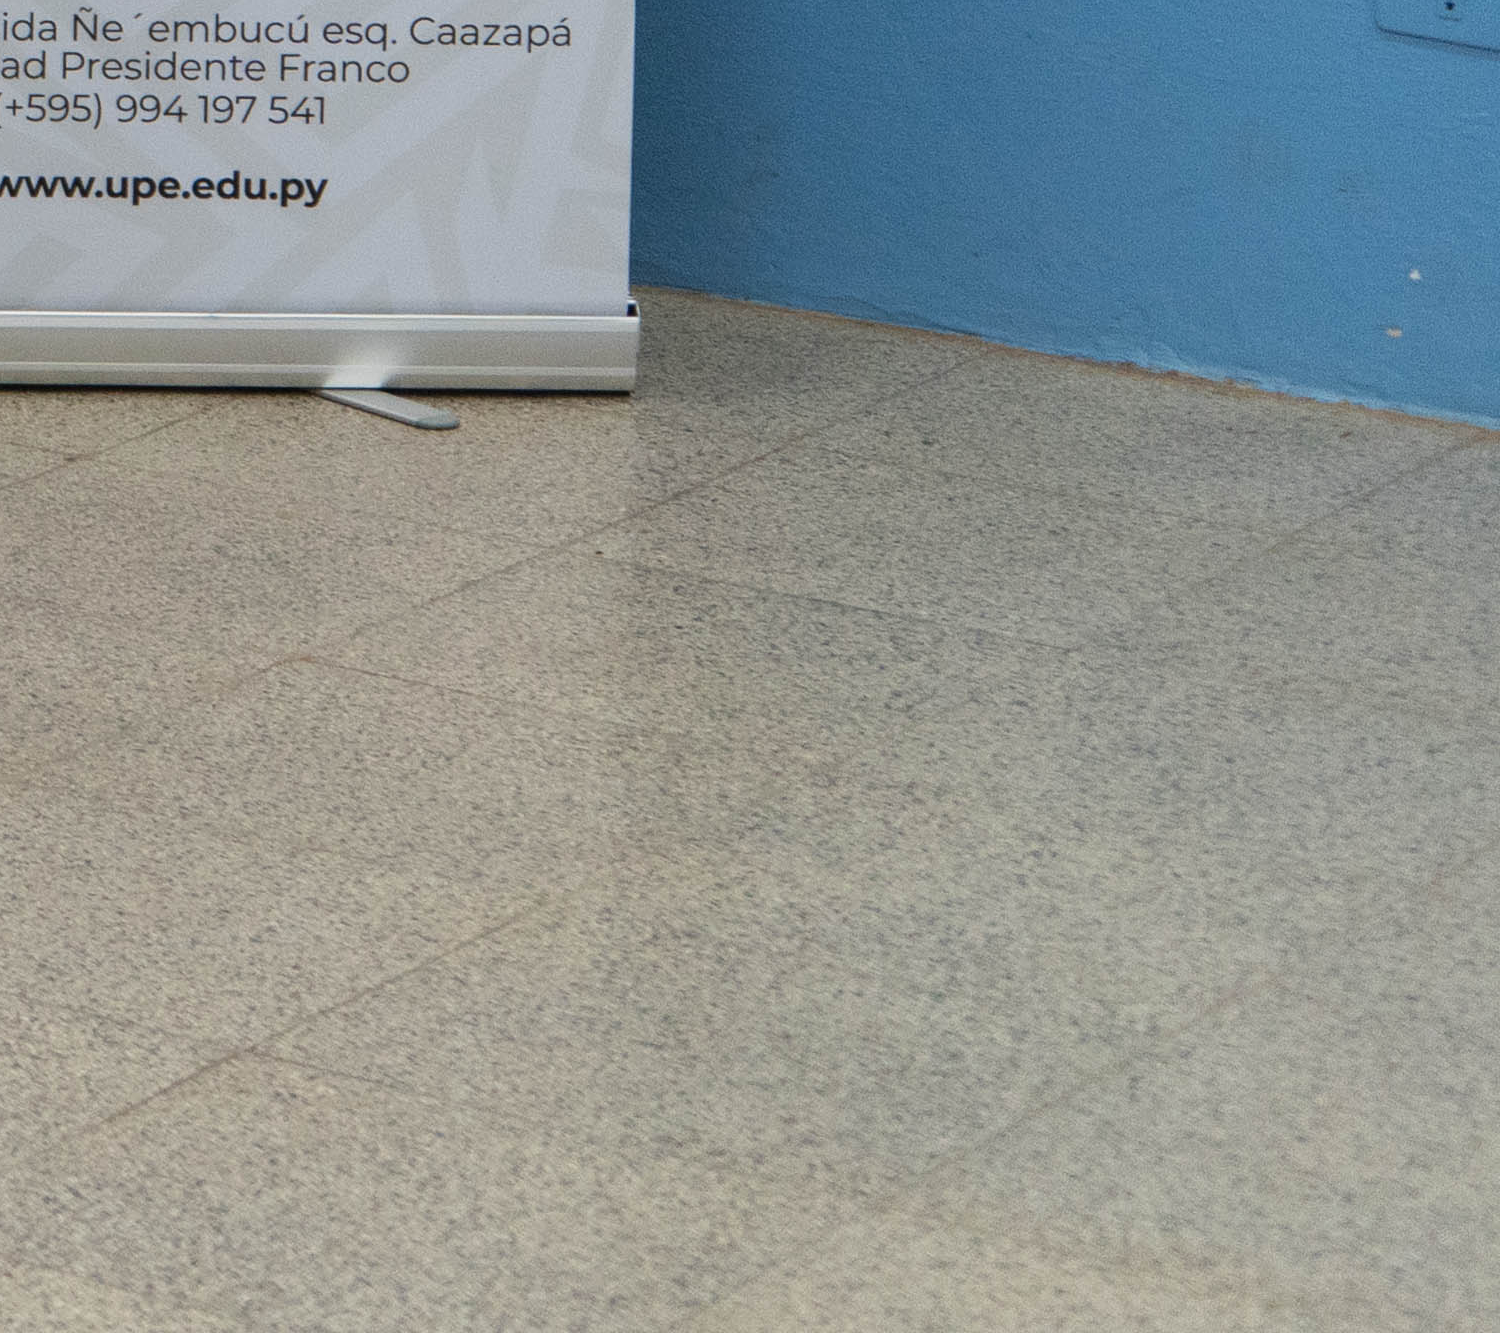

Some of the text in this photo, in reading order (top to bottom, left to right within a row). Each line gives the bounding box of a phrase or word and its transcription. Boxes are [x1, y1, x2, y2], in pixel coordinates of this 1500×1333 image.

[323, 23, 396, 51] esq.
[410, 17, 570, 53] Caazapá
[62, 51, 266, 81] Presidente
[280, 54, 410, 83] Franco
[116, 95, 188, 123] 994
[198, 95, 257, 124] 197
[269, 96, 324, 124] 541
